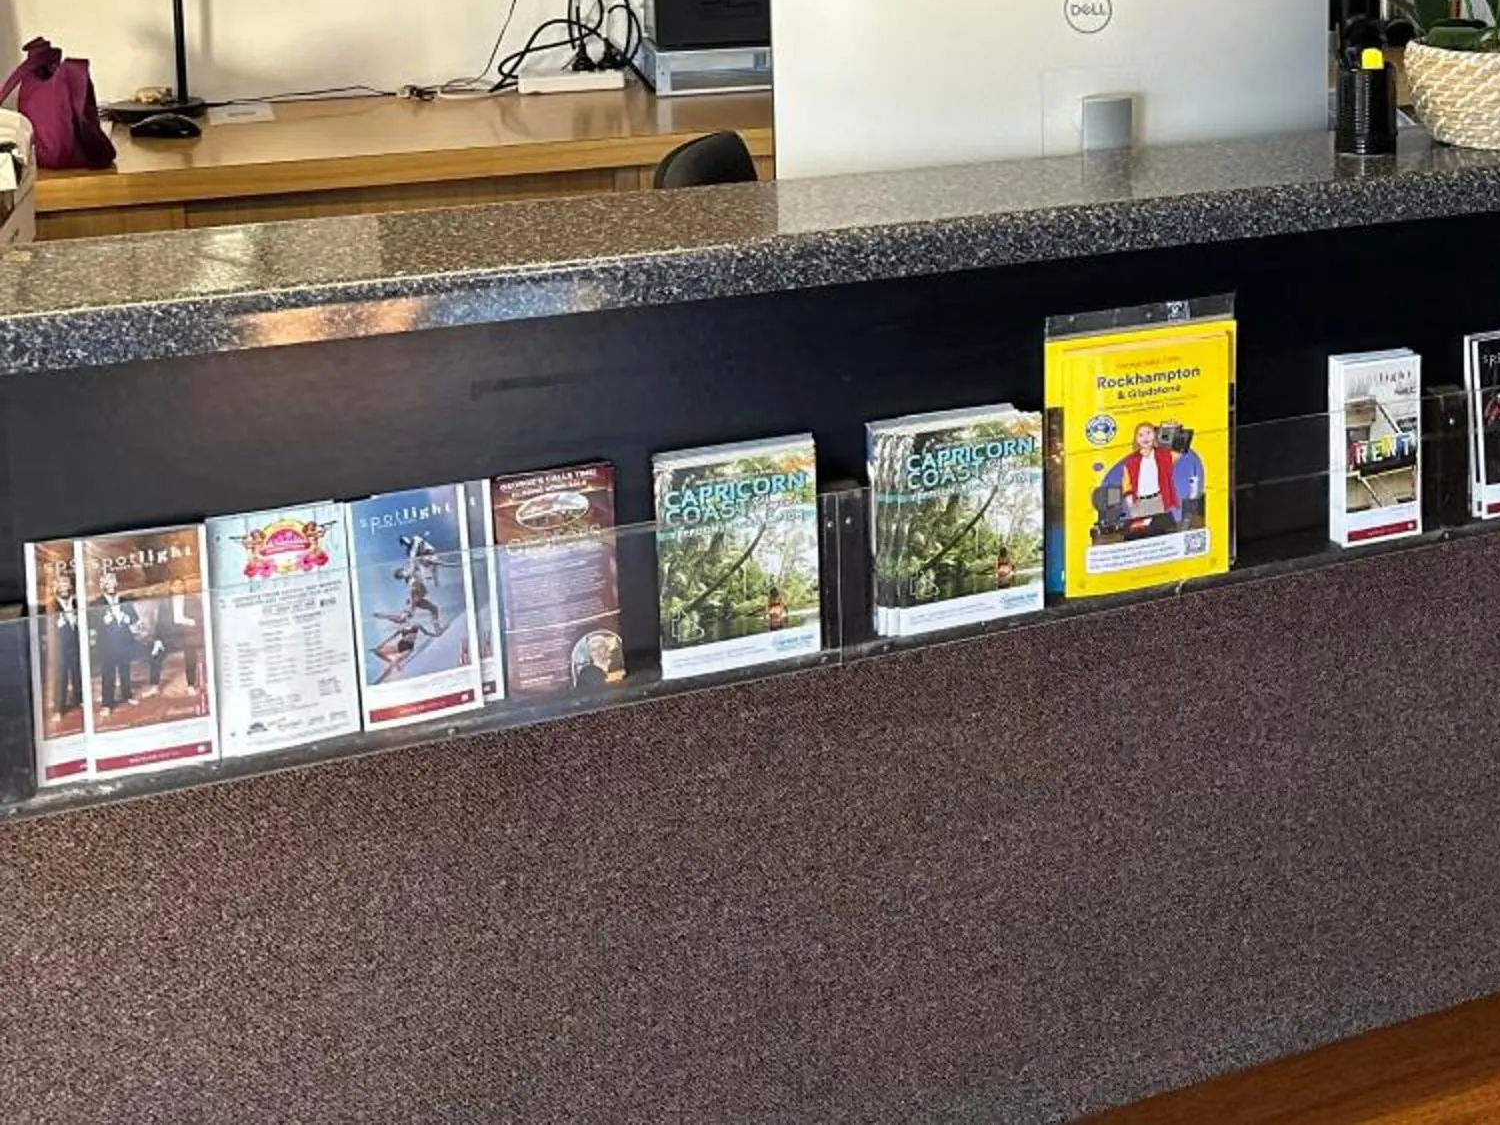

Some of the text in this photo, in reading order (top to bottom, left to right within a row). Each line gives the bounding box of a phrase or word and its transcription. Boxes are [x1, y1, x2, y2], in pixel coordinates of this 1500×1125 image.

[1070, 2, 1108, 17] DELL
[1097, 366, 1201, 390] Rockhampton
[1117, 384, 1182, 400] & Gladstone
[906, 436, 1035, 473] CAPRICORN
[1349, 433, 1411, 467] RENT
[664, 470, 808, 510] CAPRICORN
[906, 461, 982, 490] COAST
[359, 502, 453, 536] spotlight
[665, 498, 747, 526] COAST
[91, 544, 194, 575] spotlight
